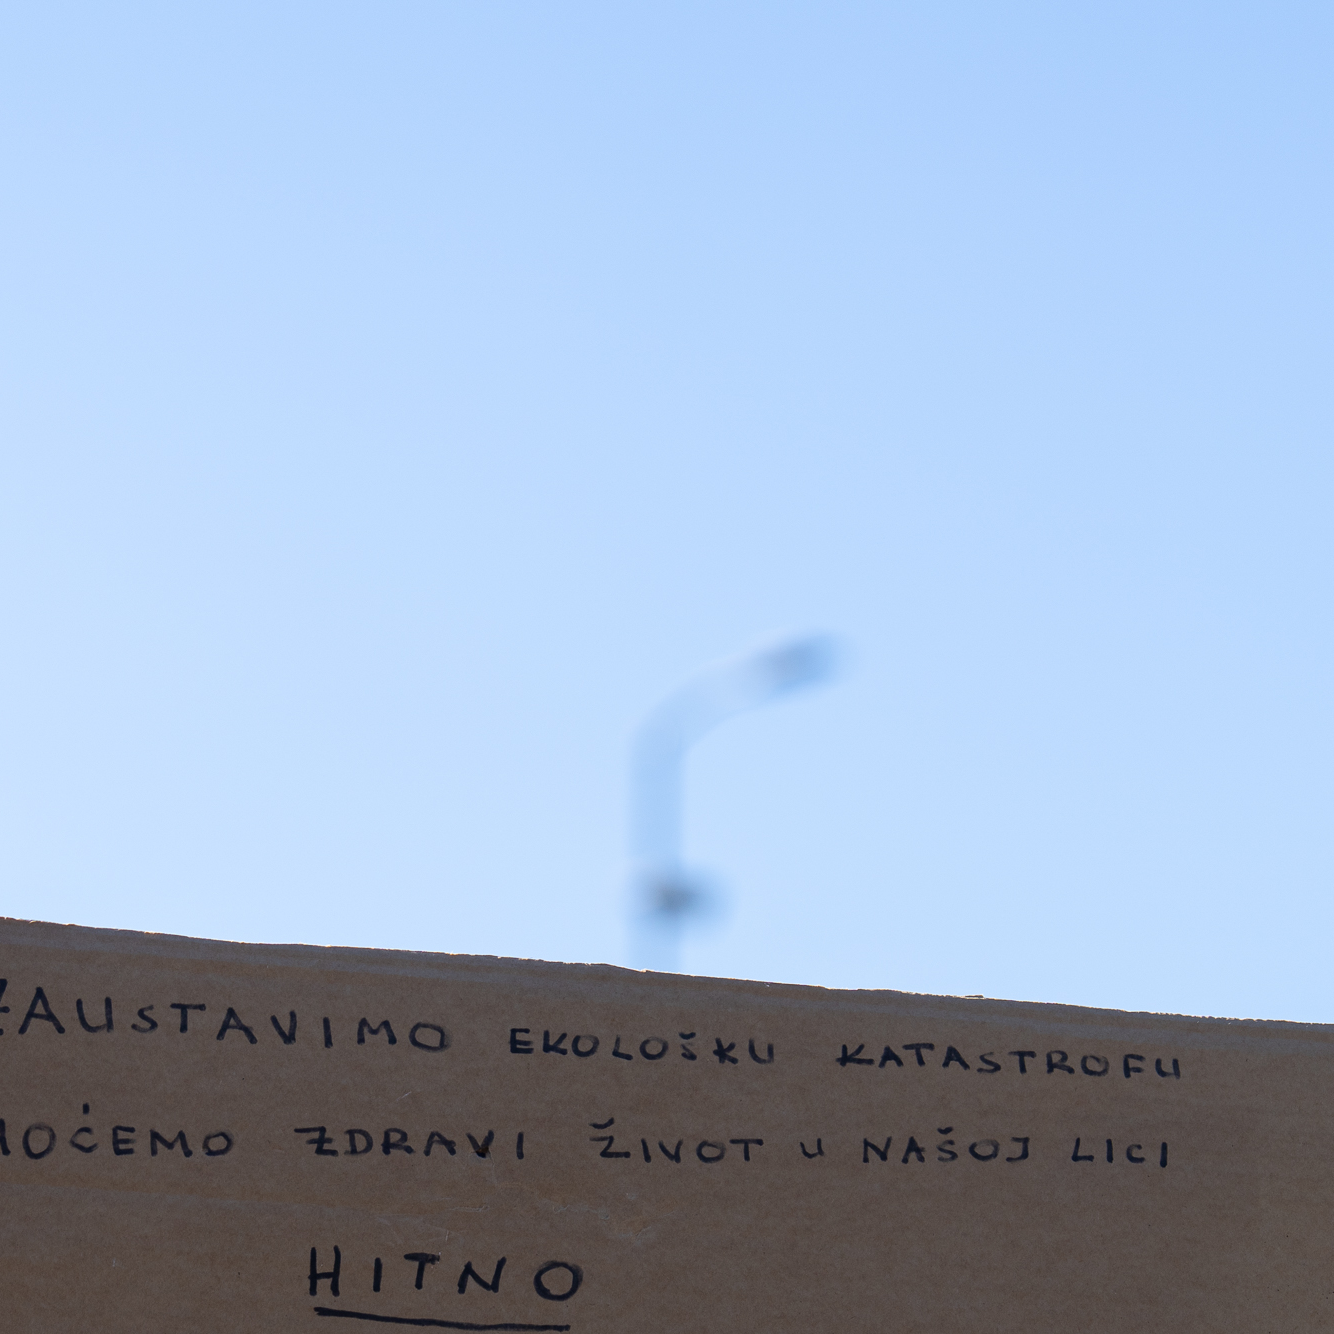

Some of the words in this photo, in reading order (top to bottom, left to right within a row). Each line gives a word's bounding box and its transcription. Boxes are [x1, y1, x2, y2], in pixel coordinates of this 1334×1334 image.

[509, 1027, 776, 1066] EKOLOŠKU
[836, 1042, 1181, 1080] KATASTROFU
[295, 1126, 526, 1160] ZDRAVI
[589, 1117, 764, 1163] ŽIVOT
[863, 1126, 1031, 1164] NAŠOJ
[1071, 1137, 1169, 1169] LICI
[309, 1245, 584, 1301] HITNO
